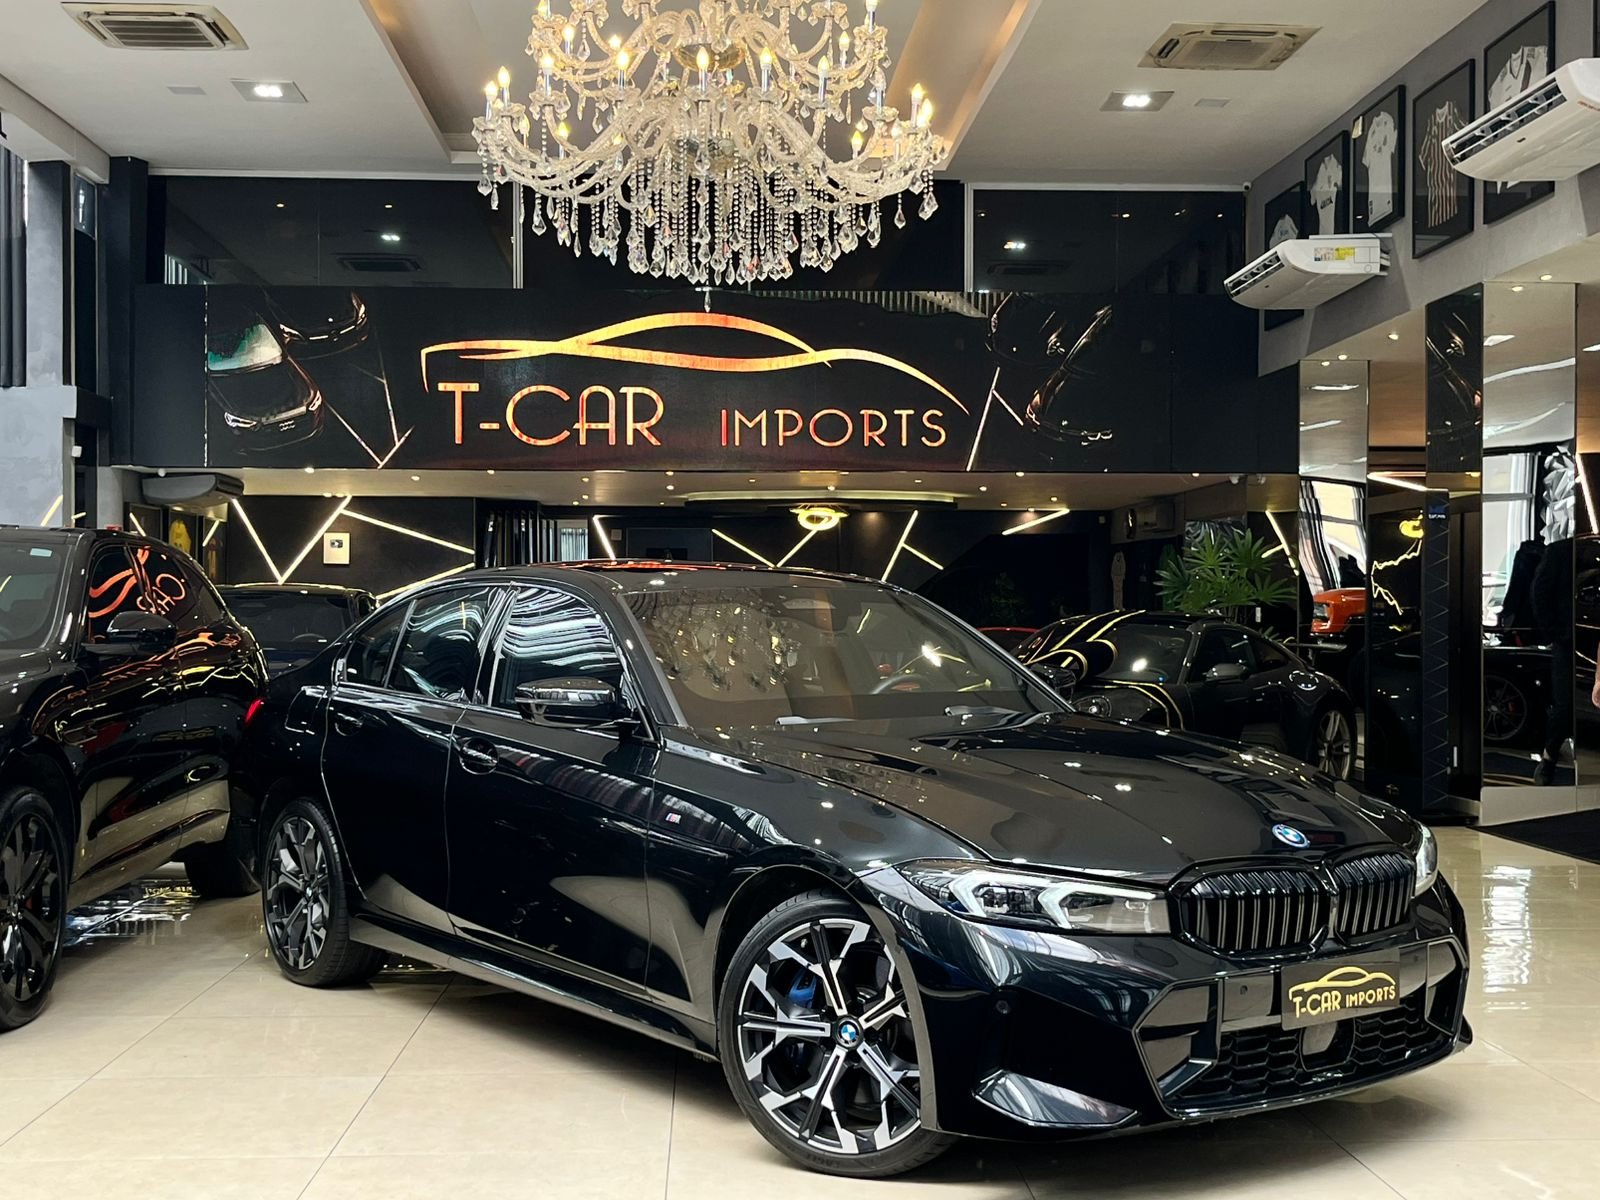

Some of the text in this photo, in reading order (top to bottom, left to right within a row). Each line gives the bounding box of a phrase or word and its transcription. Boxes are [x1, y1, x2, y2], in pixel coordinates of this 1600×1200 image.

[437, 382, 946, 448] T-CAR IMPORTS
[1293, 986, 1396, 1018] T-CAR IMPORTS
